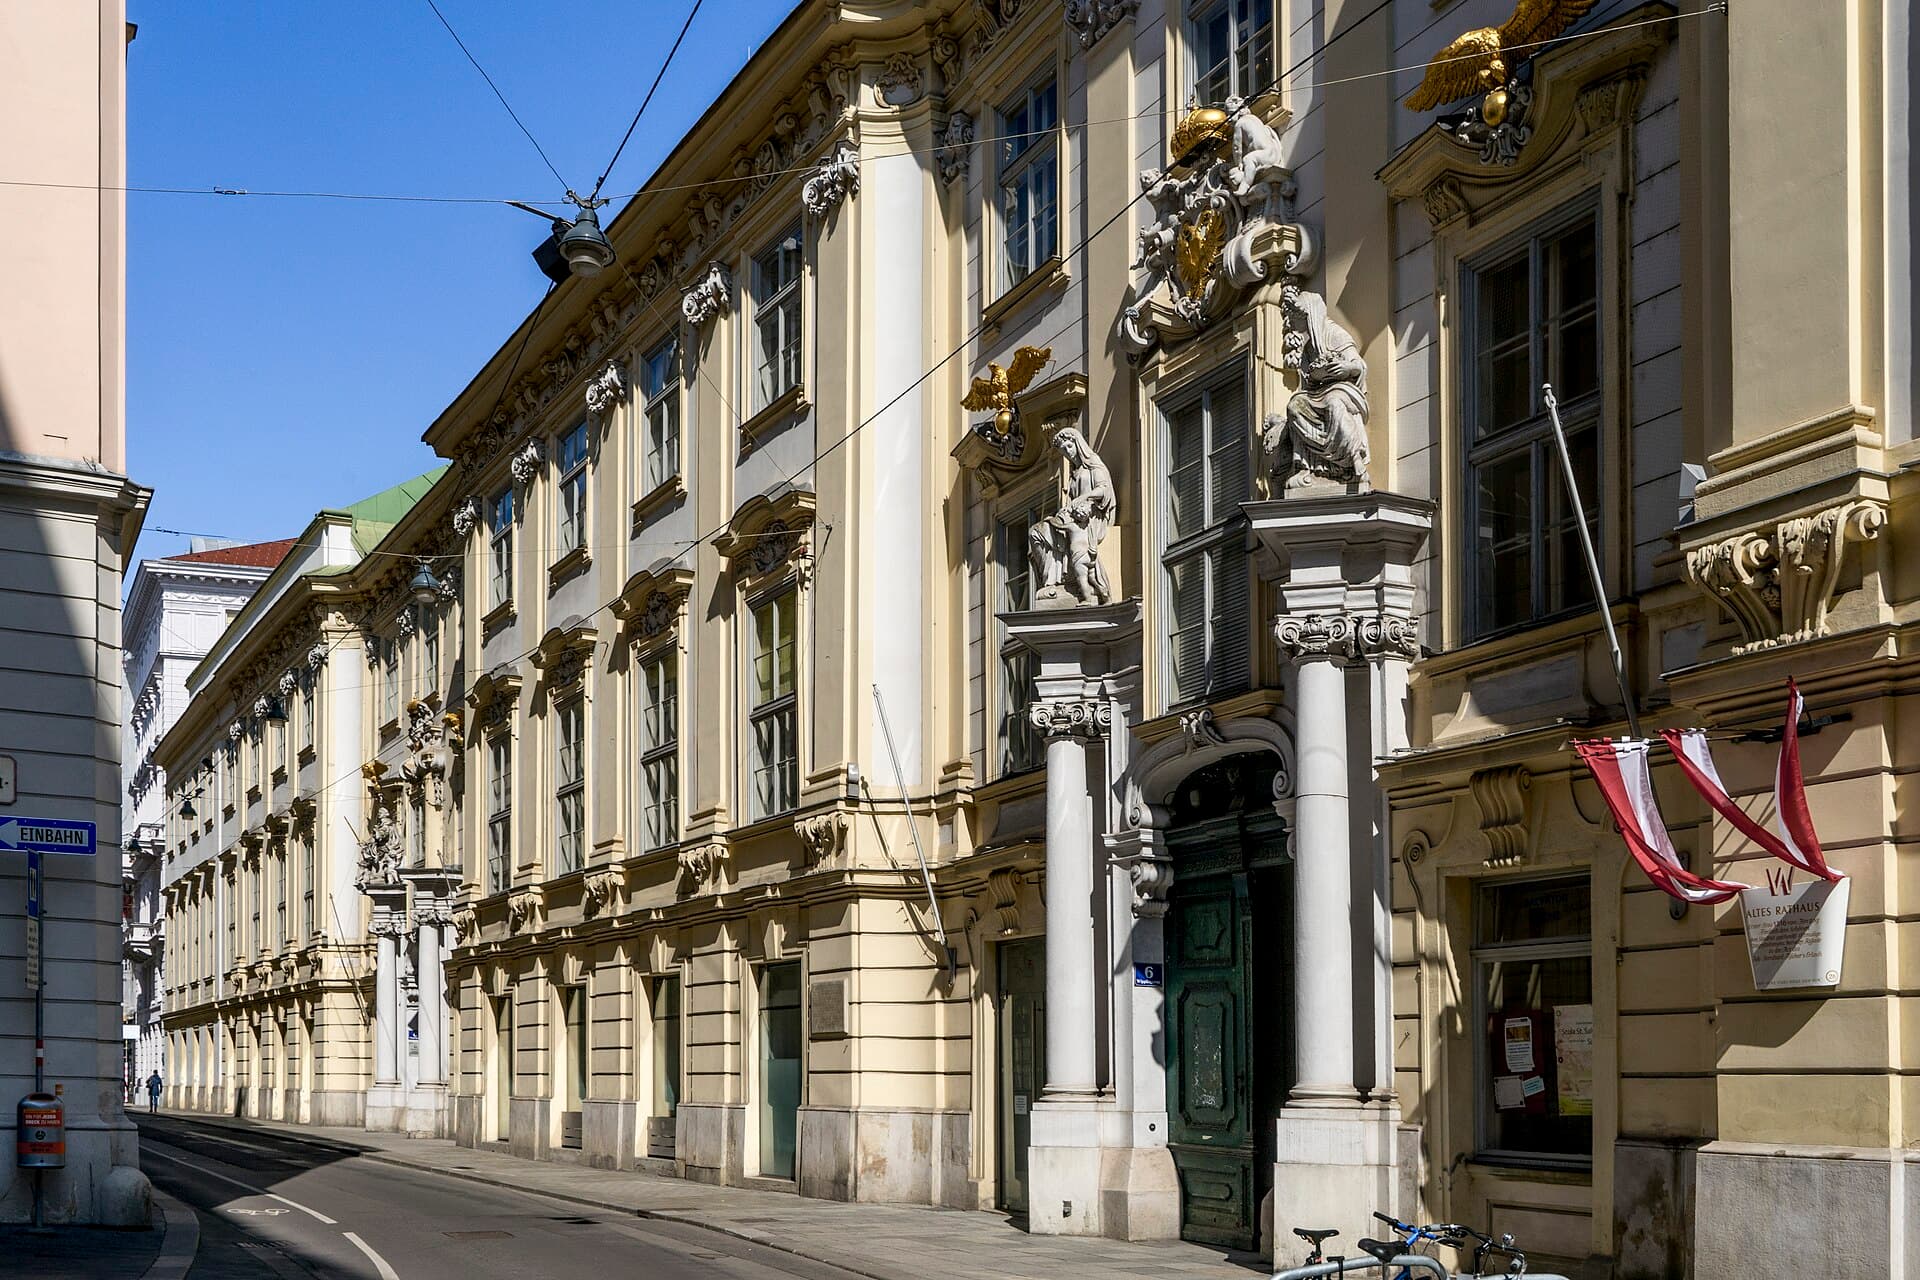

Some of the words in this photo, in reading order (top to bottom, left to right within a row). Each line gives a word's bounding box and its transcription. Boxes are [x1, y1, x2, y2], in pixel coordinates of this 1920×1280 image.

[20, 827, 84, 844] EINBAHN
[1745, 908, 1772, 919] ALTES
[1775, 902, 1821, 915] RATHAUS
[1144, 966, 1154, 979] 6
